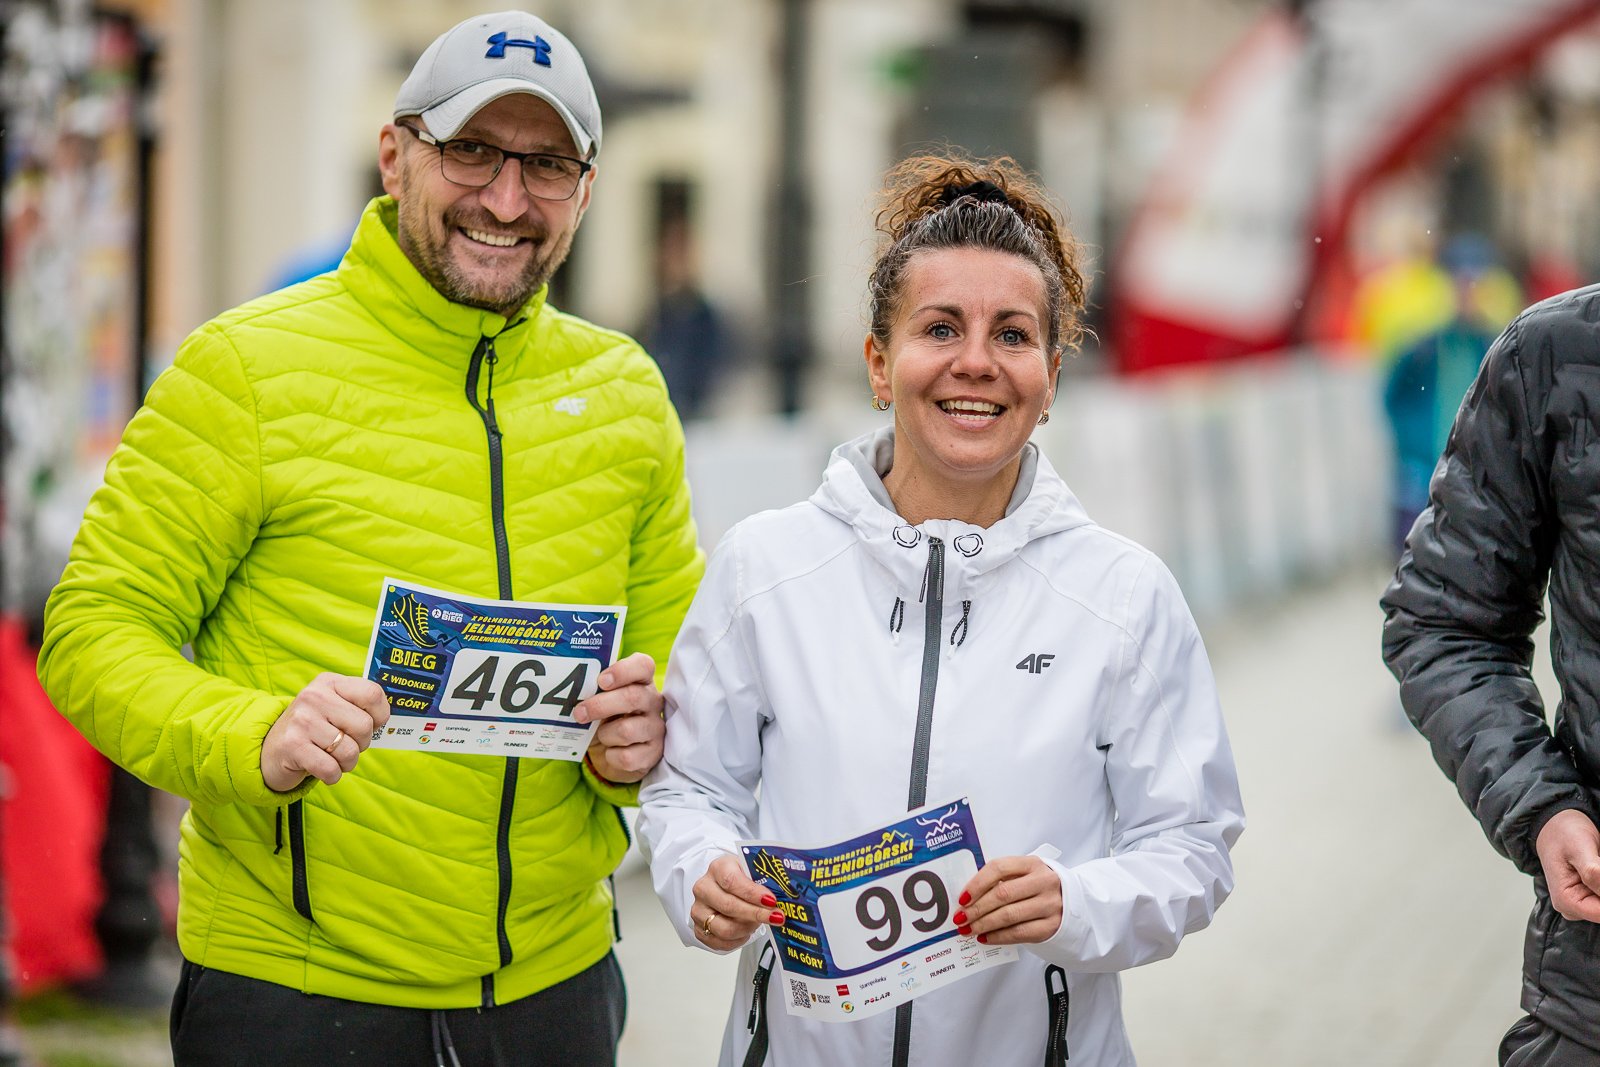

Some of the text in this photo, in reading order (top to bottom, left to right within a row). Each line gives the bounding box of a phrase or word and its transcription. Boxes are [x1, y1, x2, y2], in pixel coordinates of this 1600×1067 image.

[554, 396, 587, 416] 4F
[441, 613, 463, 623] BIEG
[461, 622, 564, 640] JELENIOGÓRSKI
[389, 647, 437, 670] BIEG
[1015, 653, 1056, 674] 4F
[381, 672, 435, 691] Z WIDOKIEM
[451, 655, 589, 717] 464
[396, 697, 429, 710] GÓRY
[810, 838, 914, 883] JELENIOGÓRSKI
[855, 870, 950, 952] 99
[781, 926, 818, 946] Z WIDOKIEM
[787, 946, 824, 969] NA GÓRY
